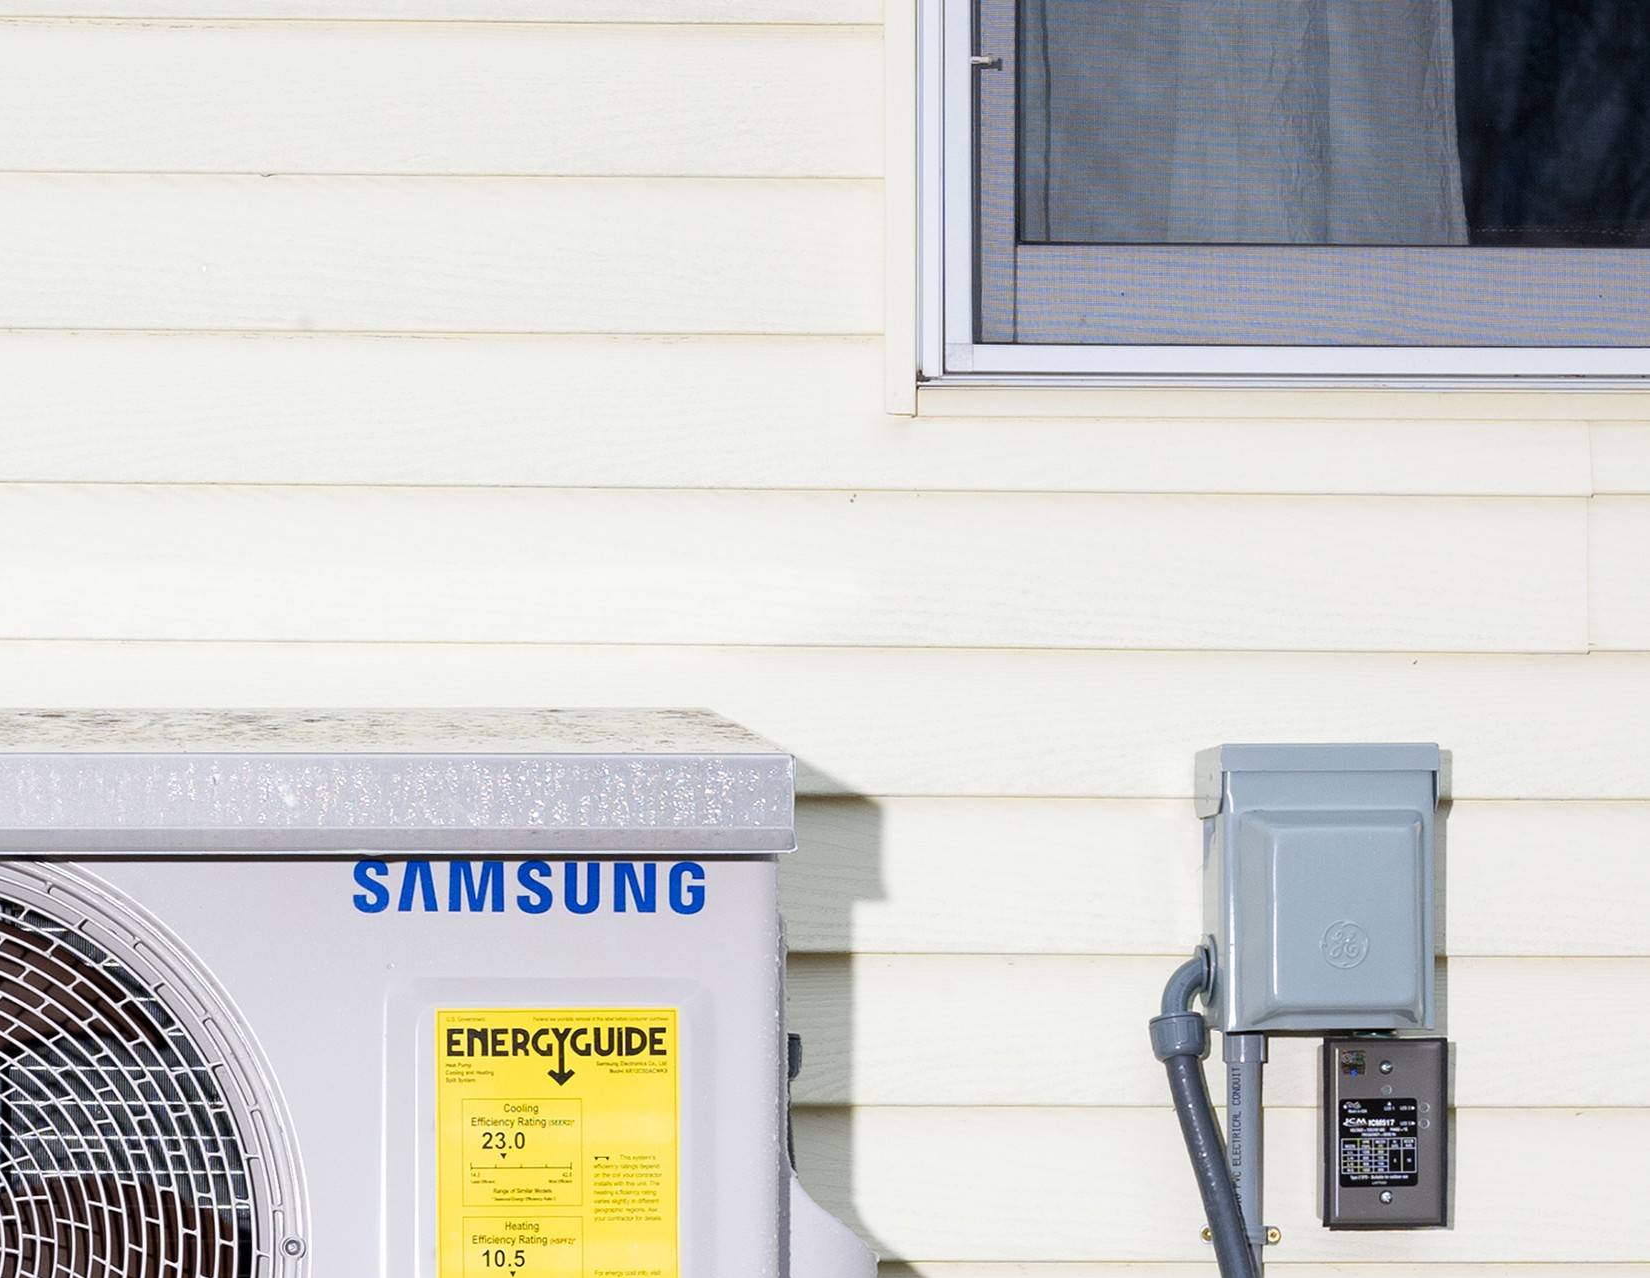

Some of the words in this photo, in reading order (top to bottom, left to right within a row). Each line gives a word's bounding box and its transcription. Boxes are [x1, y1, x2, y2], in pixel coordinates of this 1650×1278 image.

[352, 858, 704, 914] SAMSUNG
[447, 1027, 667, 1056] ENERGYGUIDE
[1231, 1067, 1241, 1106] CONDUIT
[504, 1104, 539, 1115] Cooling
[471, 1117, 514, 1128] Efficiency
[518, 1117, 546, 1128] Rating
[482, 1132, 525, 1149] 23.0
[1232, 1111, 1241, 1166] ELECTRICAL
[505, 1222, 539, 1233] Heating
[472, 1235, 516, 1246] Efficiency
[519, 1235, 547, 1246] Rating
[482, 1250, 525, 1267] 10.5
